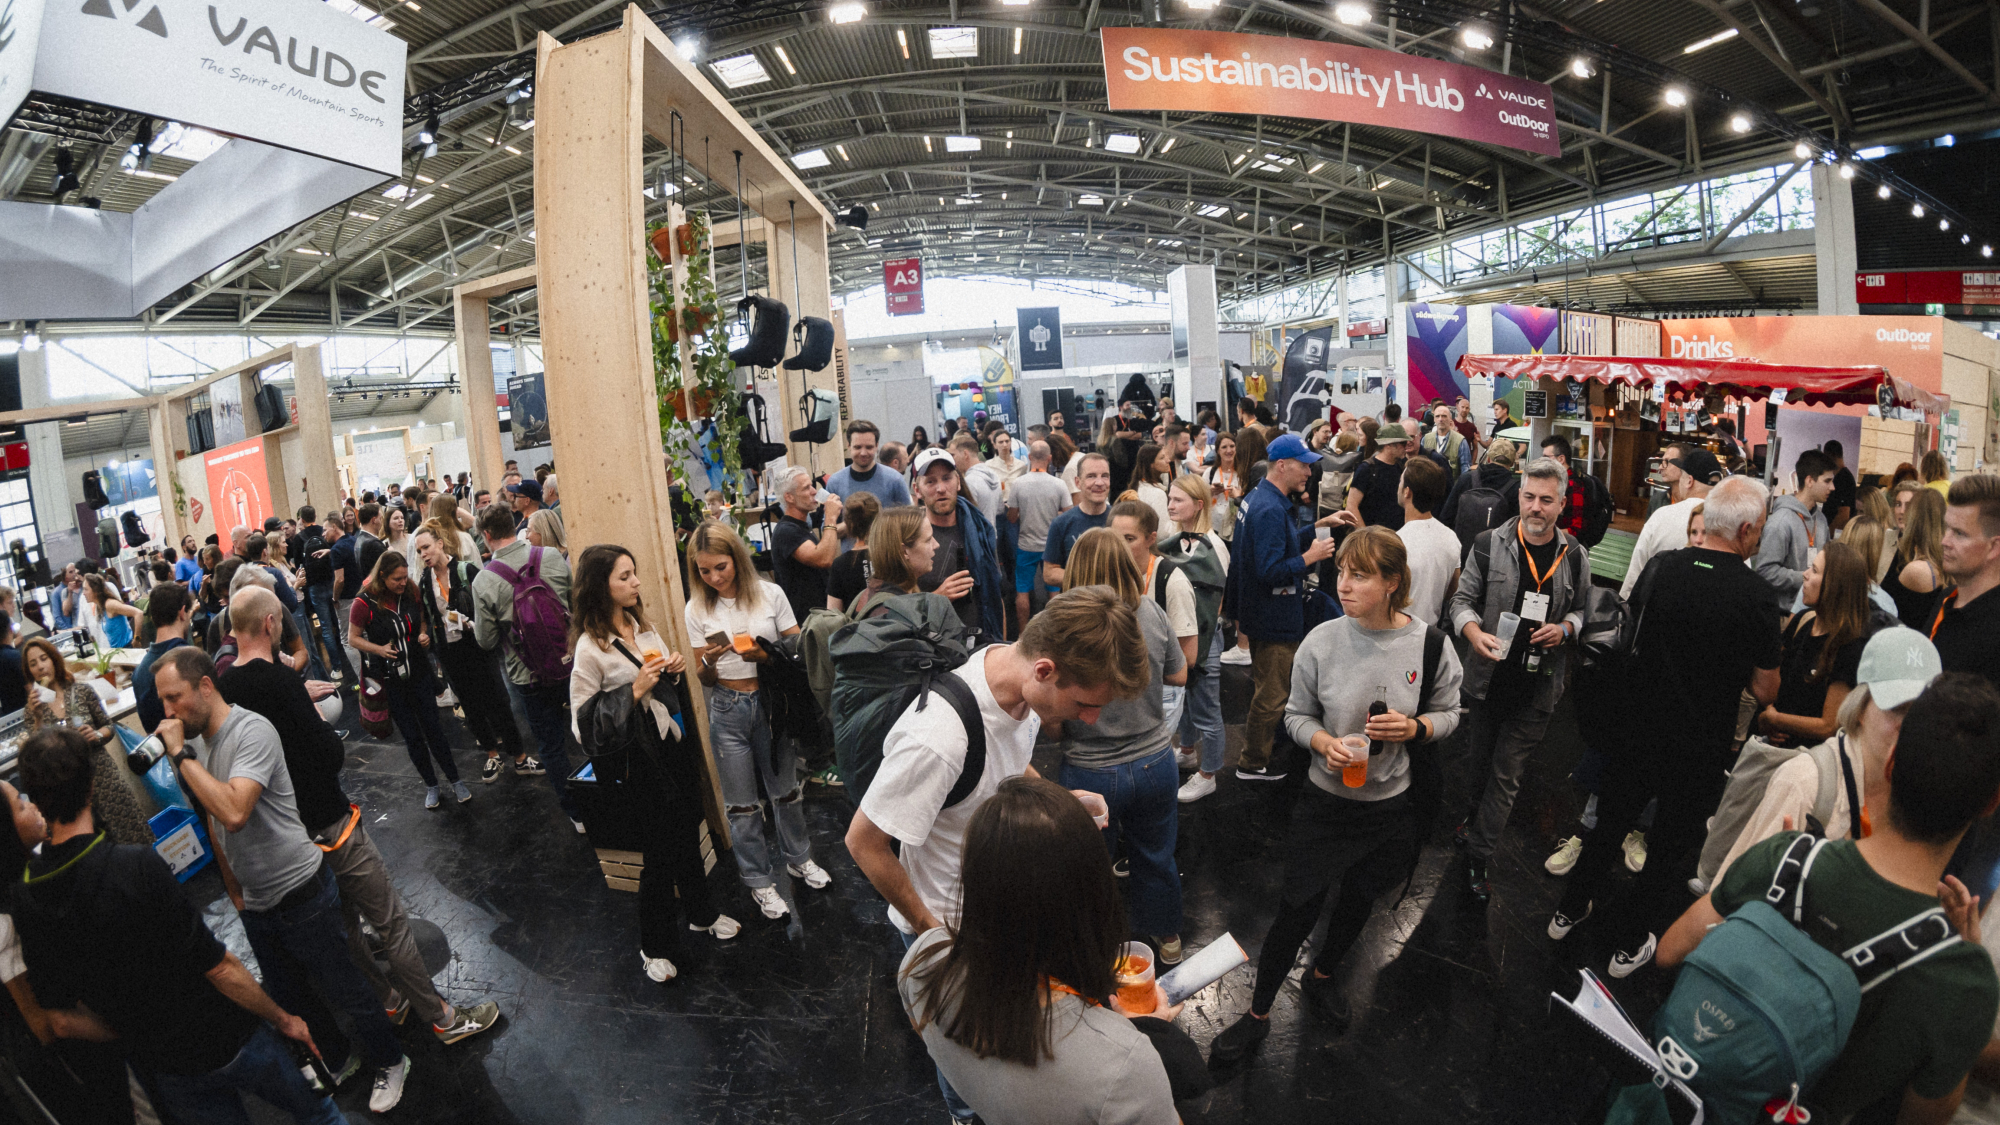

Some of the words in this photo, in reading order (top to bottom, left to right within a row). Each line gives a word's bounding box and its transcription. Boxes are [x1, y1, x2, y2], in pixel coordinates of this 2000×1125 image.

[208, 5, 386, 104] VAUDE
[1123, 46, 1391, 108] Sustainability
[1394, 70, 1465, 112] Hub
[201, 57, 225, 75] The
[230, 67, 269, 84] Spirit
[271, 82, 288, 93] of
[286, 86, 346, 114] Mountain
[350, 107, 385, 127] Sports
[1498, 89, 1547, 109] VAUDE
[1498, 110, 1549, 132] OutDoor
[894, 269, 919, 286] A3
[1671, 335, 1734, 359] Drinks
[1876, 328, 1932, 343] OutDoor
[835, 348, 849, 420] REPAIRABILITY
